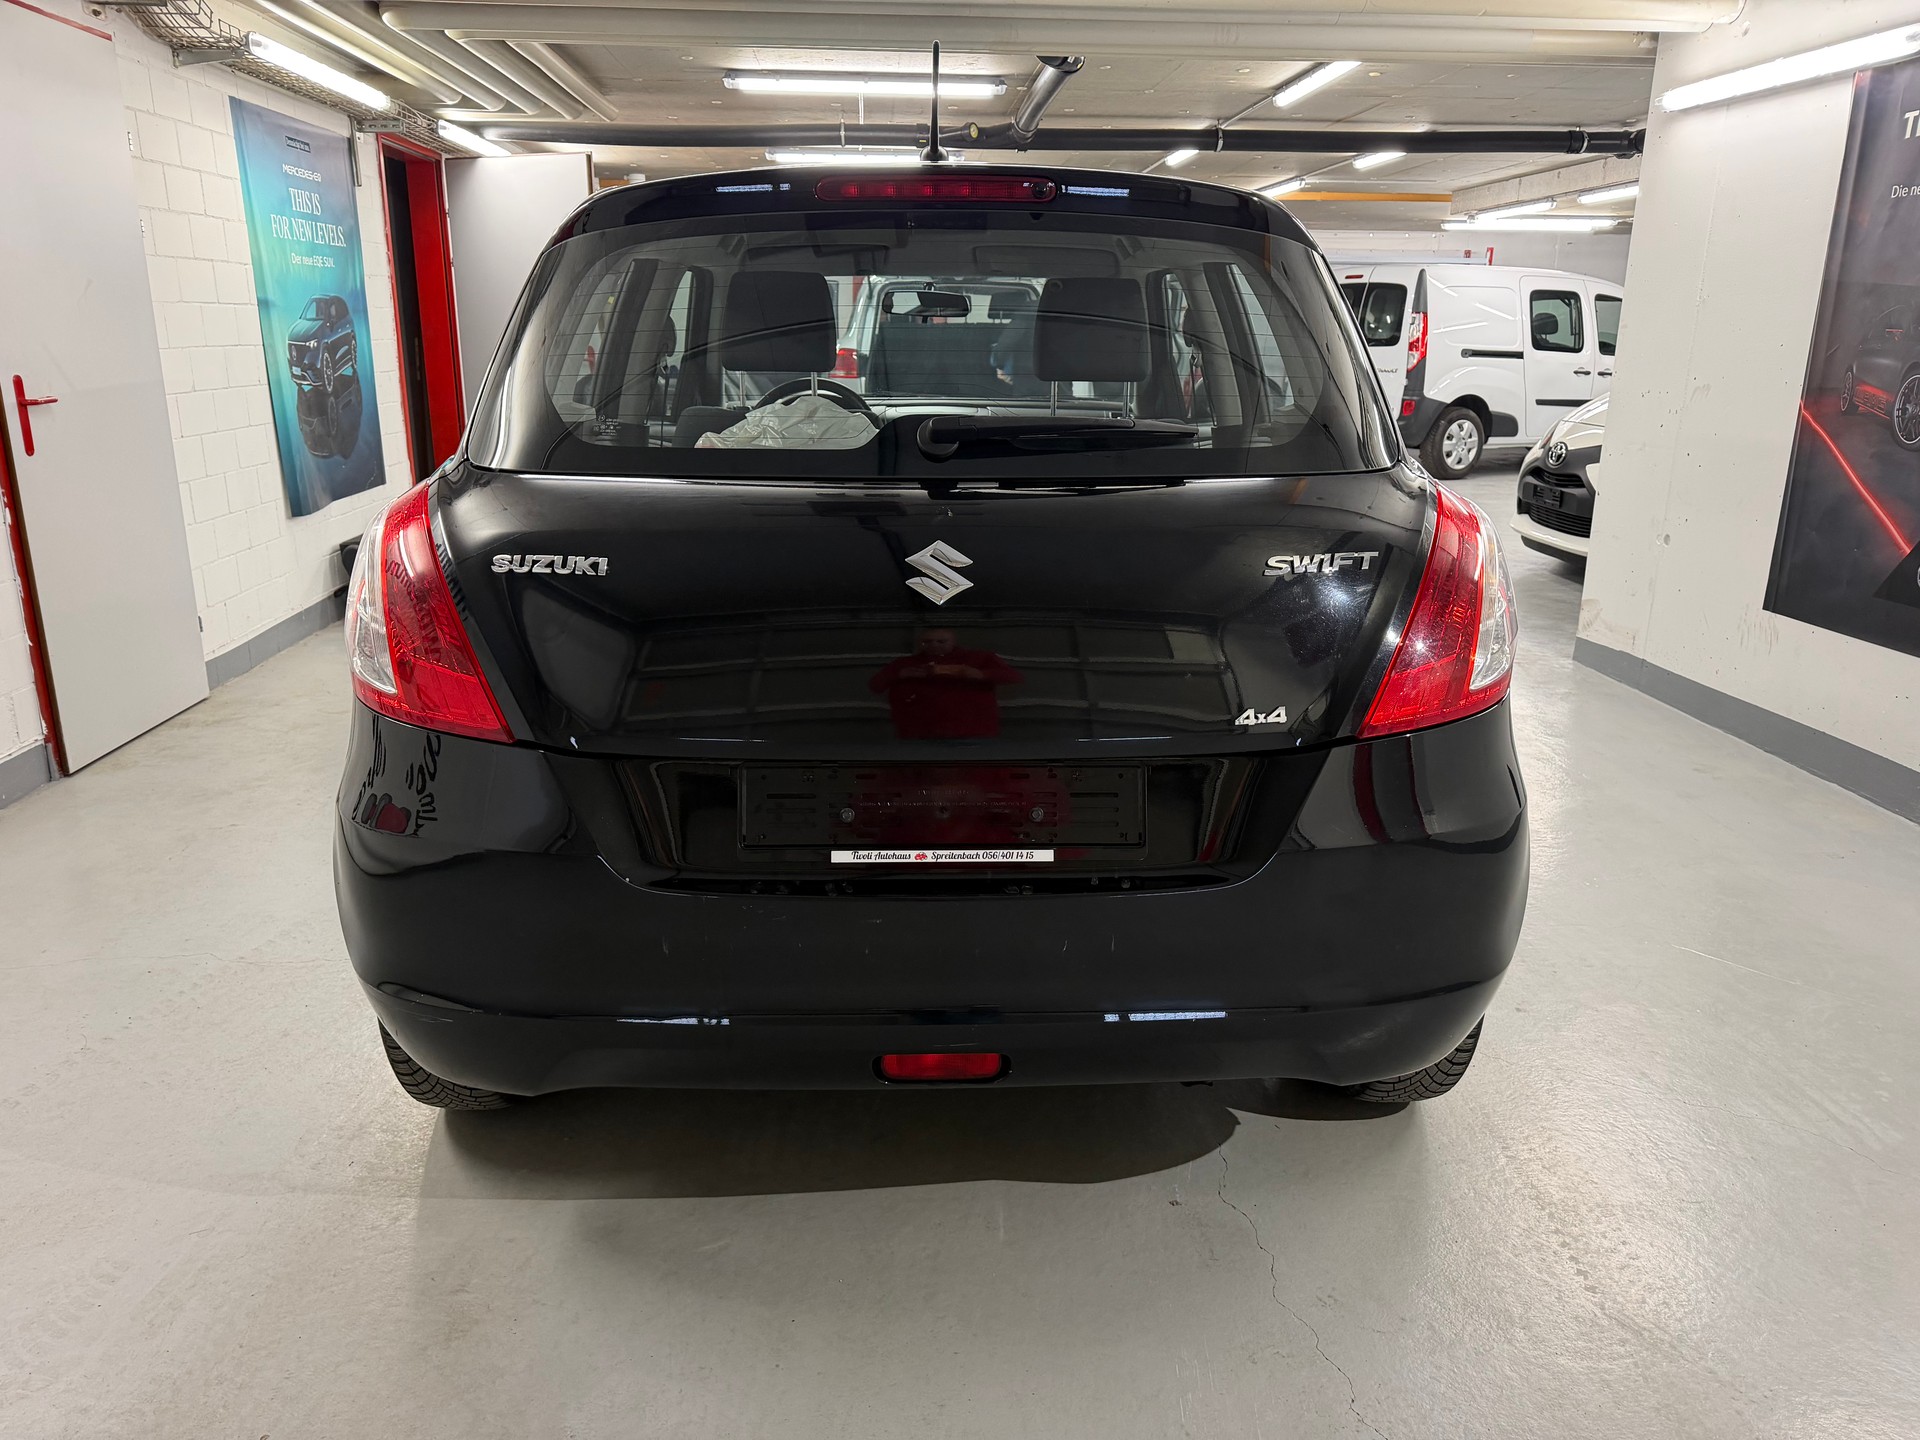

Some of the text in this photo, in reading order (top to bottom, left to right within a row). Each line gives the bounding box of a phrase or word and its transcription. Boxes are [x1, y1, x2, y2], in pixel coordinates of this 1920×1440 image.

[282, 163, 322, 182] MERCEDES-EQ
[288, 187, 321, 215] THIS IS
[1891, 184, 1908, 198] Die
[270, 213, 346, 247] FOR NEW LEVELS.
[291, 252, 302, 264] Der
[313, 255, 324, 268] EQE
[491, 554, 608, 576] SUZUKI
[1264, 551, 1379, 576] SWIFT
[1234, 706, 1288, 726] 4x4
[851, 851, 1034, 862] Tivoli Autohaus Spreitenbach 056/401 14 15
